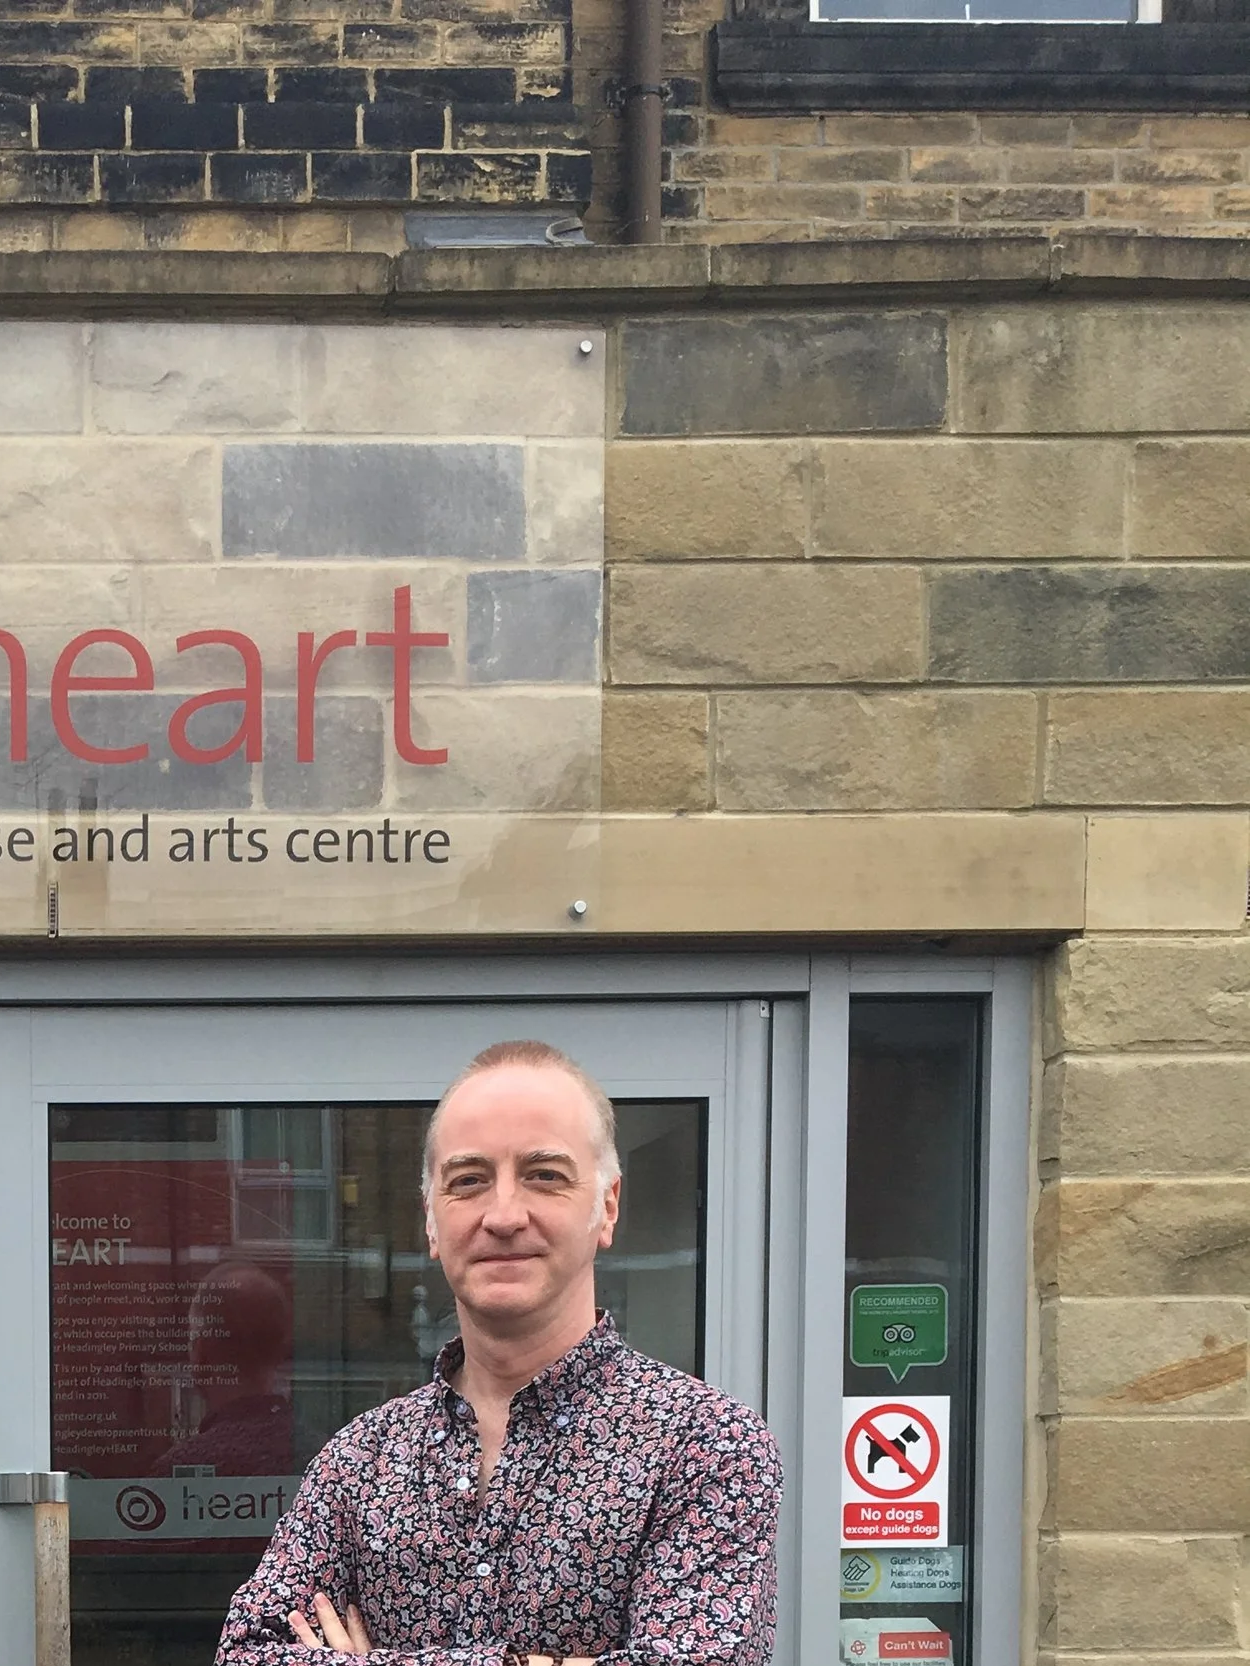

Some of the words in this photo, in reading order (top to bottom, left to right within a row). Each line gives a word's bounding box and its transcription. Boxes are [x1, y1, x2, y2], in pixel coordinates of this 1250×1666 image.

[52, 813, 150, 863] and
[168, 816, 269, 863] arts
[285, 817, 451, 863] centre
[52, 1213, 109, 1230] lcome
[113, 1213, 131, 1230] to
[52, 1238, 131, 1266] EART
[72, 1280, 93, 1290] and
[93, 1280, 147, 1292] welcoming
[148, 1282, 175, 1293] space
[70, 1295, 102, 1307] people
[155, 1293, 180, 1303] work
[183, 1293, 201, 1303] and
[859, 1297, 939, 1306] RECOMMENDED
[71, 1317, 90, 1327] you
[91, 1316, 117, 1328] enjoy
[120, 1315, 156, 1327] visiting
[157, 1314, 175, 1324] and
[177, 1315, 205, 1327] using
[206, 1314, 225, 1324] this
[63, 1329, 92, 1339] which
[94, 1329, 136, 1341] occupies
[137, 1328, 154, 1338] the
[156, 1328, 201, 1341] buildings
[202, 1328, 213, 1338] of
[214, 1328, 230, 1338] the
[63, 1342, 117, 1355] Headingley
[119, 1342, 157, 1355] Primary
[872, 1347, 924, 1357] tripadvisor
[71, 1364, 88, 1373] run
[89, 1362, 102, 1375] by
[103, 1363, 122, 1373] and
[124, 1362, 138, 1373] for
[139, 1362, 156, 1373] the
[158, 1362, 181, 1373] local
[58, 1377, 78, 1389] part
[80, 1376, 91, 1387] of
[92, 1376, 147, 1389] Headingley
[149, 1376, 213, 1389] Development
[55, 1390, 74, 1401] ned
[75, 1390, 85, 1400] in
[182, 1485, 287, 1521] heart
[860, 1508, 882, 1521] No
[885, 1507, 924, 1523] dogs
[845, 1525, 879, 1536] except
[881, 1524, 911, 1536] guide
[912, 1524, 939, 1535] dogs
[890, 1556, 917, 1565] Guide
[918, 1556, 941, 1567] Dogs
[926, 1568, 950, 1578] Dogs
[890, 1580, 937, 1589] Assistance
[938, 1580, 962, 1590] Dogs
[884, 1641, 916, 1651] Can't
[917, 1640, 944, 1650] Wait
